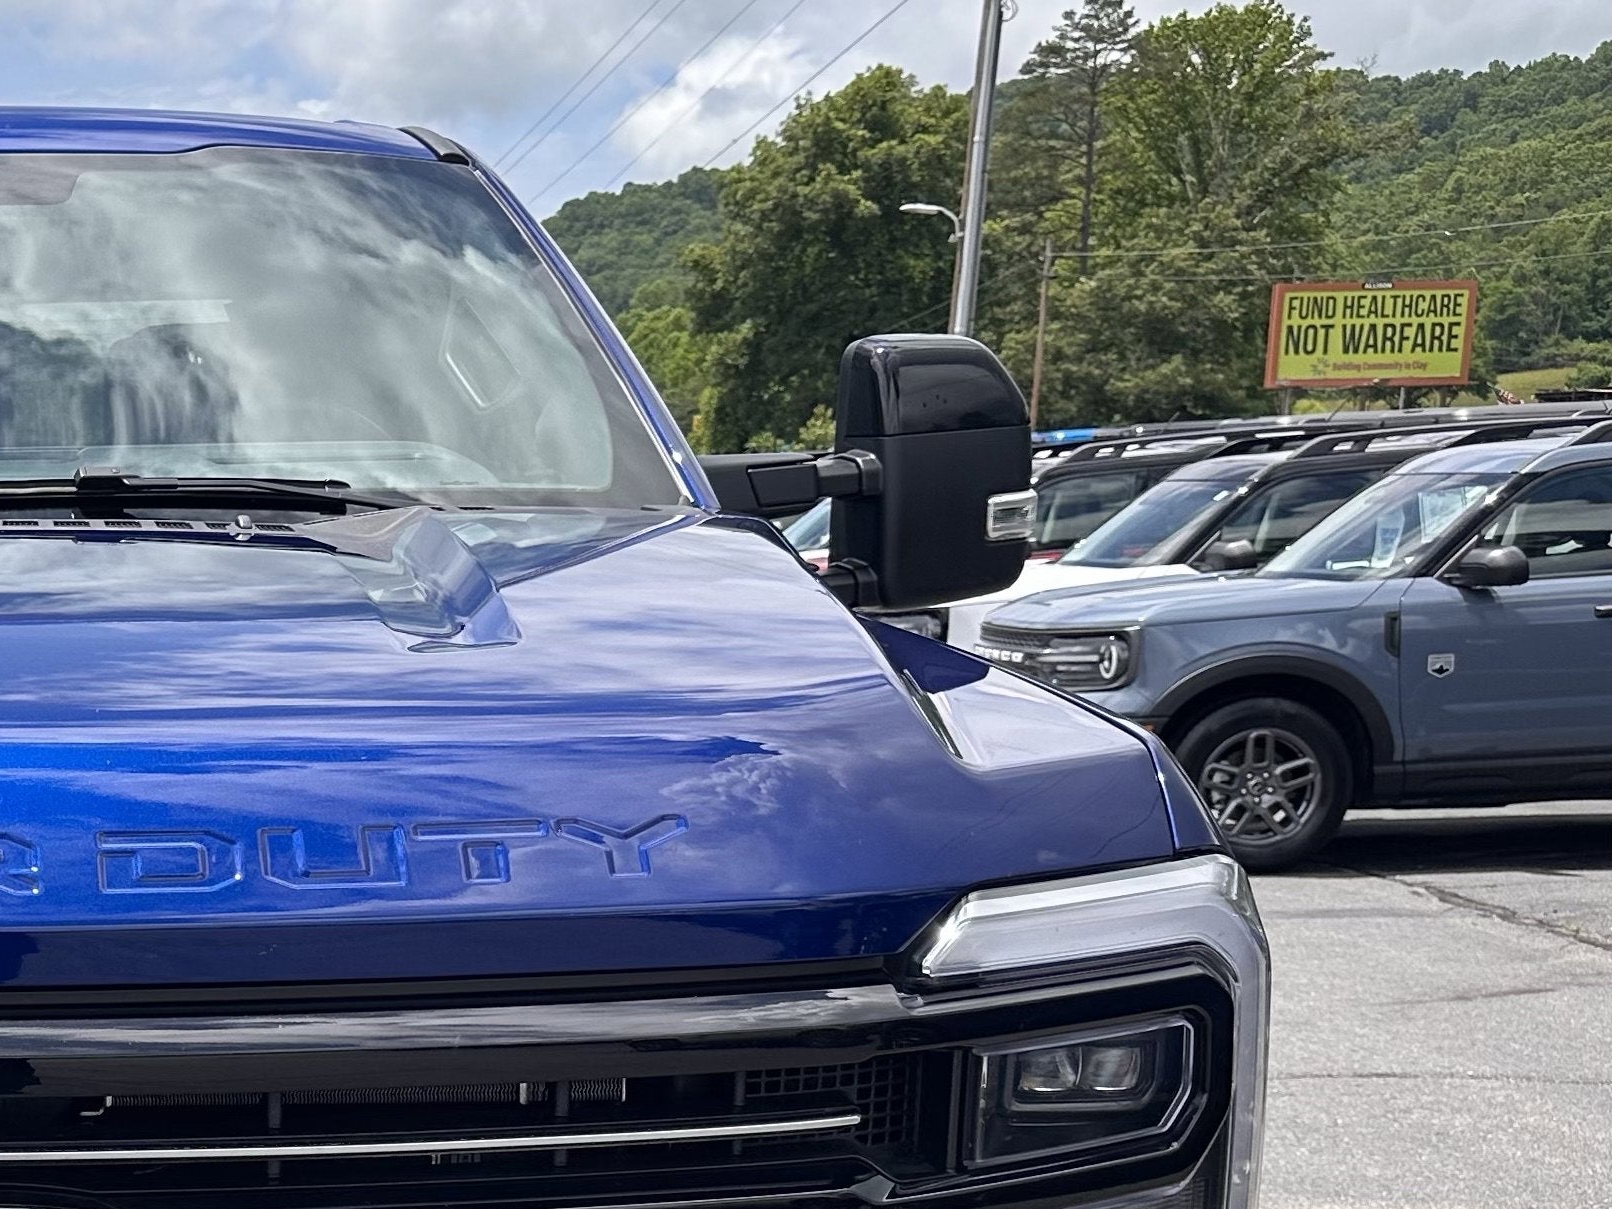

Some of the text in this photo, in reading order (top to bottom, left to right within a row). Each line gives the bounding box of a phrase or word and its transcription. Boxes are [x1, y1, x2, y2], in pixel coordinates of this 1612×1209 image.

[1288, 293, 1464, 321] FUND HEALTHCARE
[1284, 322, 1461, 356] NOT WARFARE
[95, 813, 688, 893] DUTY
